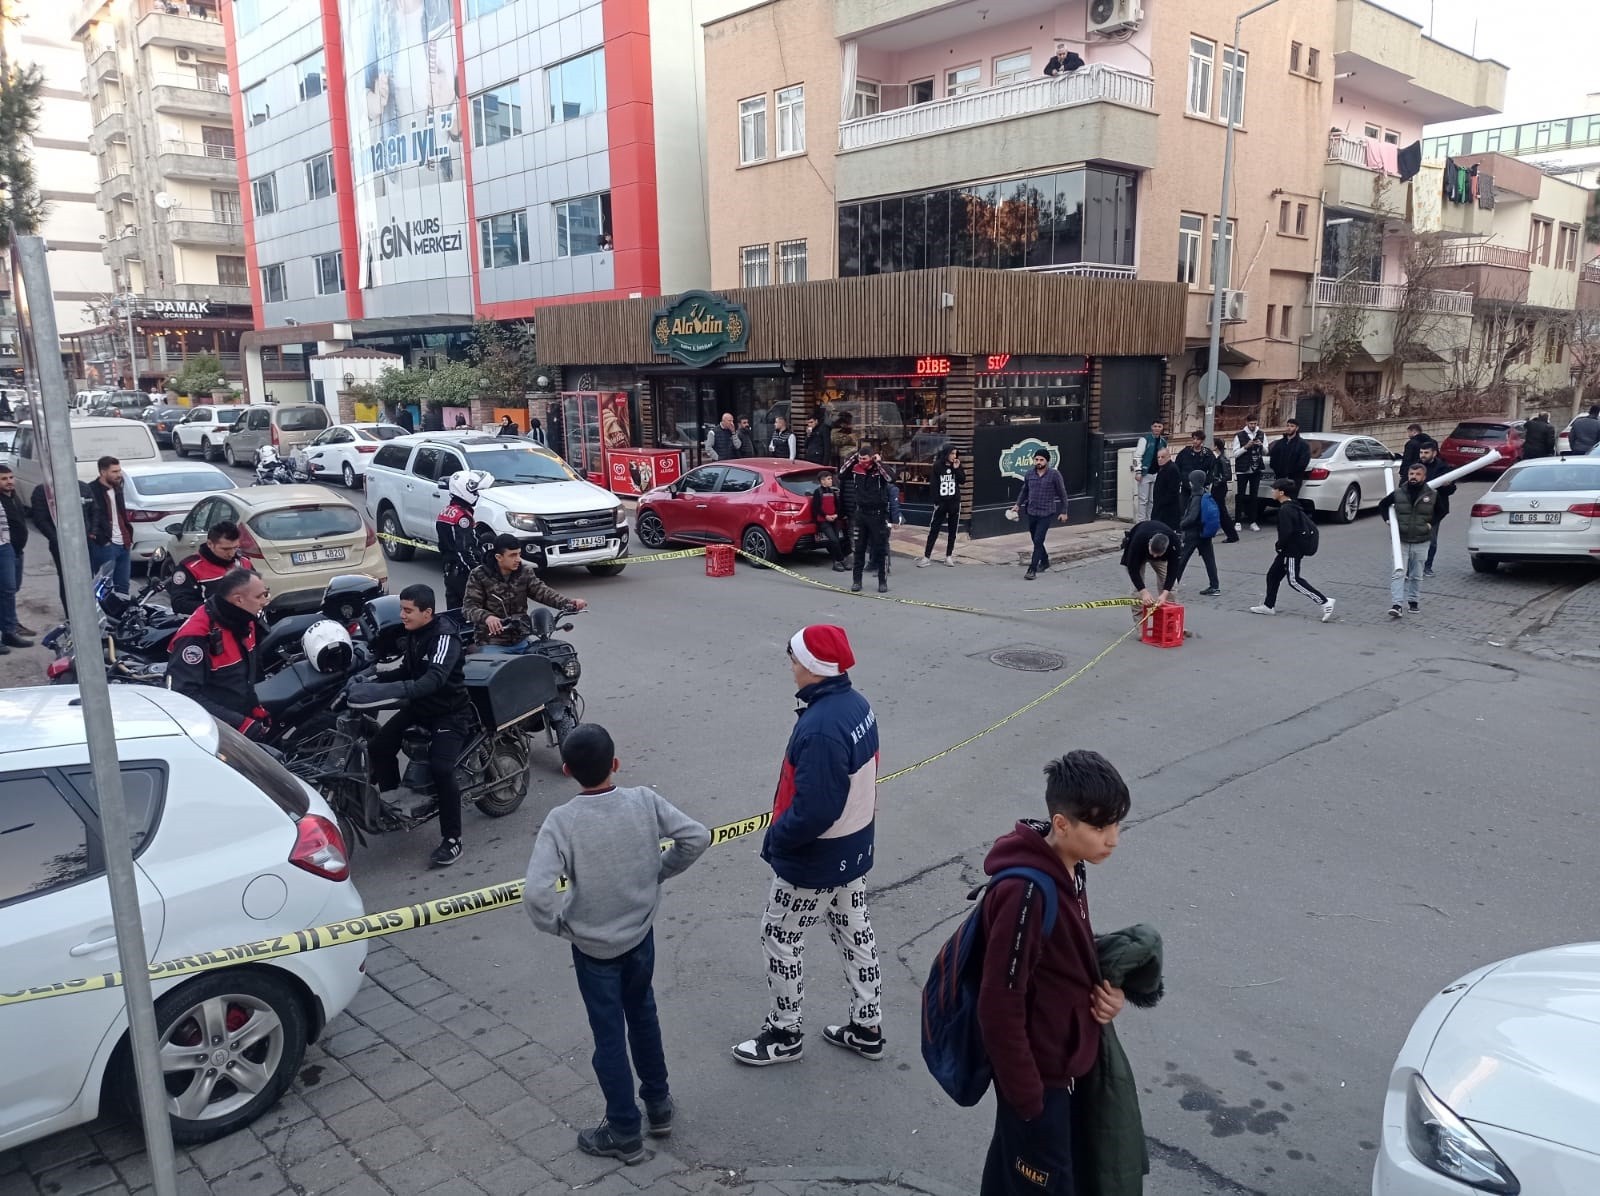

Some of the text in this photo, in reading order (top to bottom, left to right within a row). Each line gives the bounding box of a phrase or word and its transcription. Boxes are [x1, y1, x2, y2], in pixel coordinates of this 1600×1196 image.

[413, 217, 441, 237] KURS
[154, 301, 210, 313] DAMAK
[940, 481, 956, 496] 88
